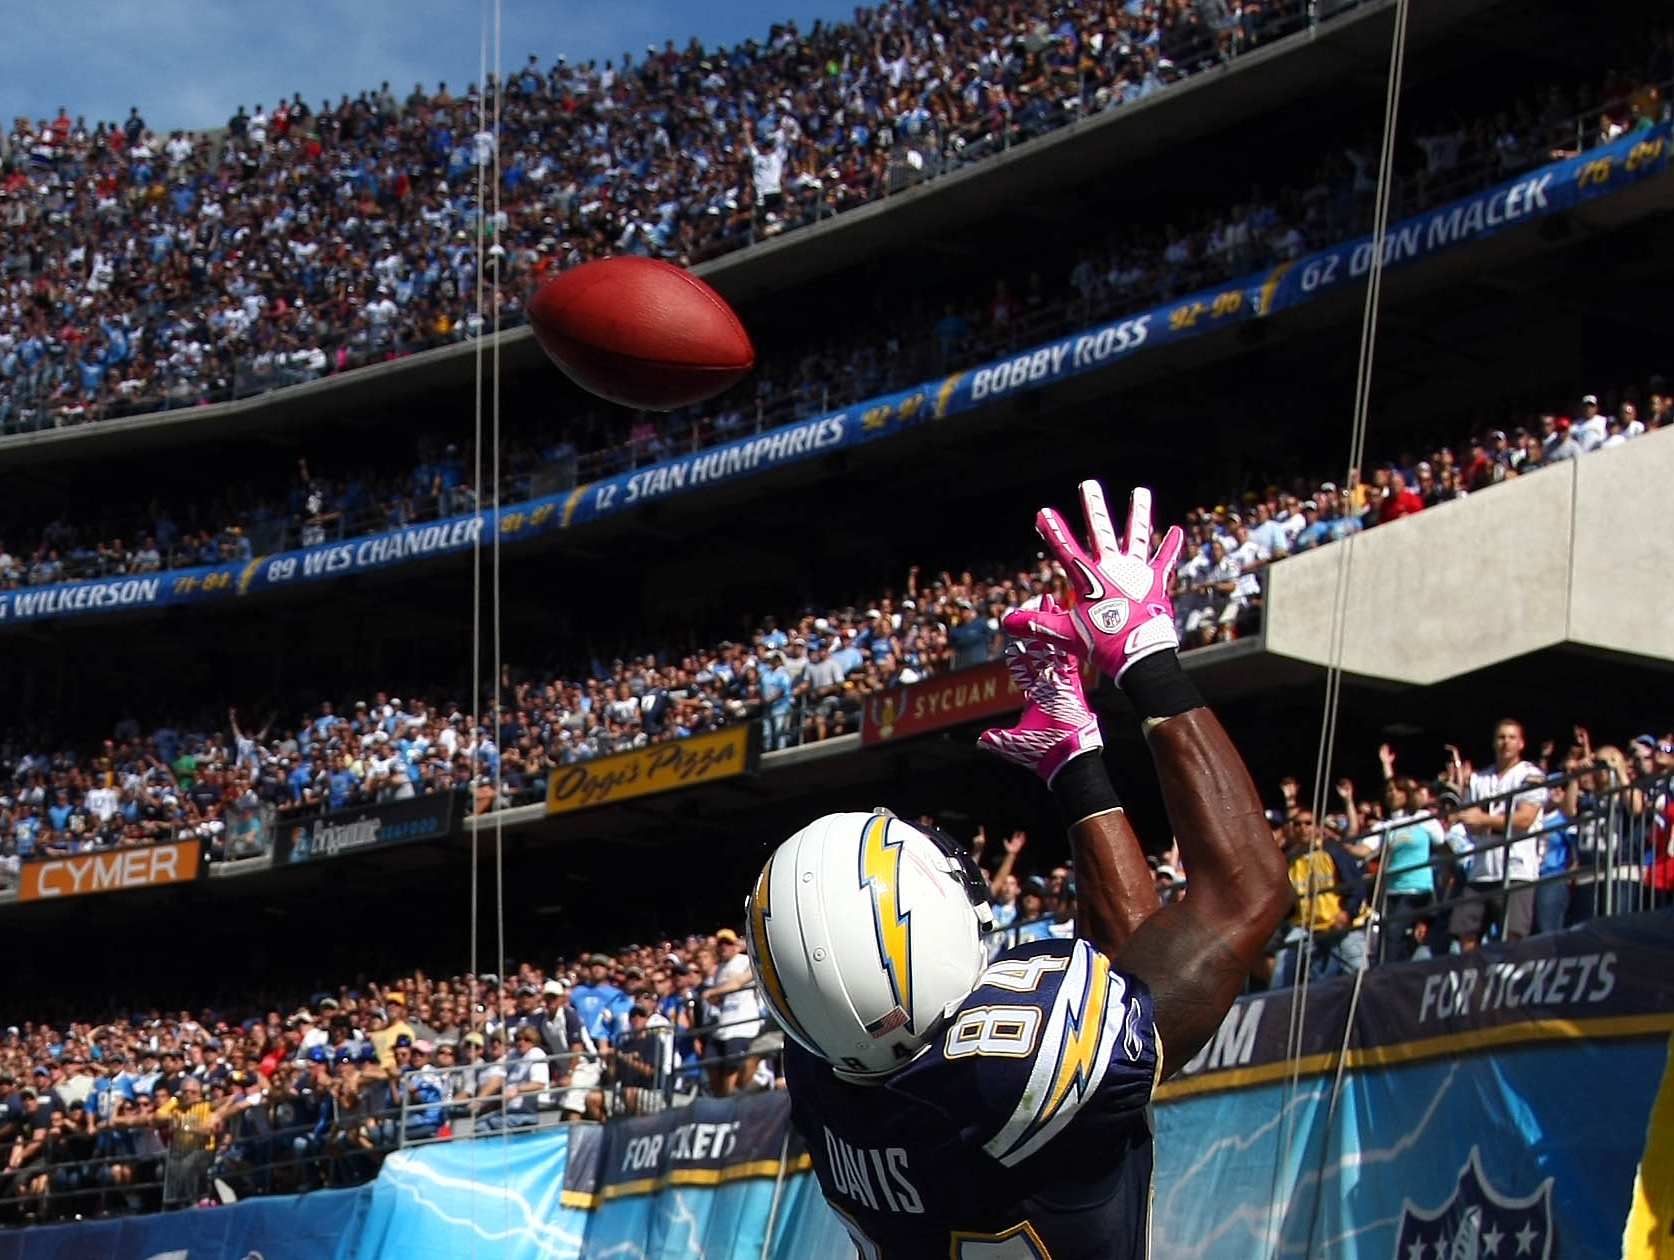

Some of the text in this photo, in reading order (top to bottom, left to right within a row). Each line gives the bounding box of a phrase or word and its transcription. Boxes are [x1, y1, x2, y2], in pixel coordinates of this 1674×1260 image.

[1301, 254, 1340, 292] 62
[1348, 225, 1423, 278] DON
[1427, 172, 1554, 250] MACEK
[971, 341, 1071, 401] BOBBY
[1073, 314, 1152, 368] ROSS
[595, 484, 617, 511] 12
[625, 464, 688, 504] STAN
[689, 413, 847, 486] HUMPHRIES
[267, 557, 295, 583] 89
[303, 542, 355, 577] WES
[356, 515, 484, 567] CHANDLER
[14, 576, 160, 619] WILKERSON
[914, 676, 997, 720] SYCUAN
[37, 846, 179, 897] CYMER
[943, 953, 1070, 1060] 84
[1419, 952, 1618, 1025] FOR TICKETS
[622, 1134, 664, 1172] FOR
[823, 1126, 926, 1214] DAVIS
